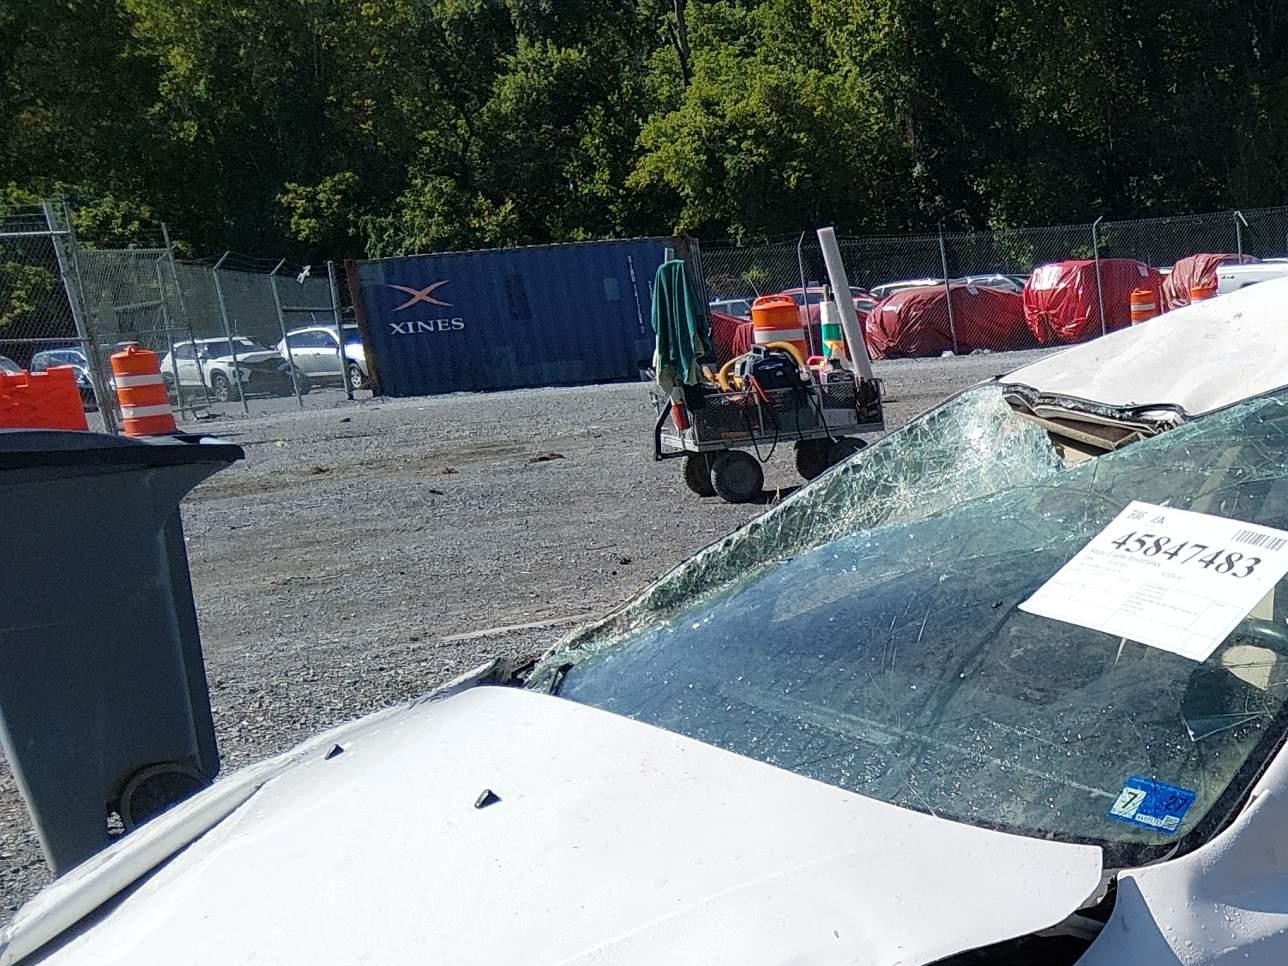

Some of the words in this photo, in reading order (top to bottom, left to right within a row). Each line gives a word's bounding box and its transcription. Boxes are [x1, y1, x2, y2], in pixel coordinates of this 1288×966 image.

[389, 317, 465, 335] XINES
[1111, 531, 1262, 579] 45847483
[1122, 791, 1138, 809] 7
